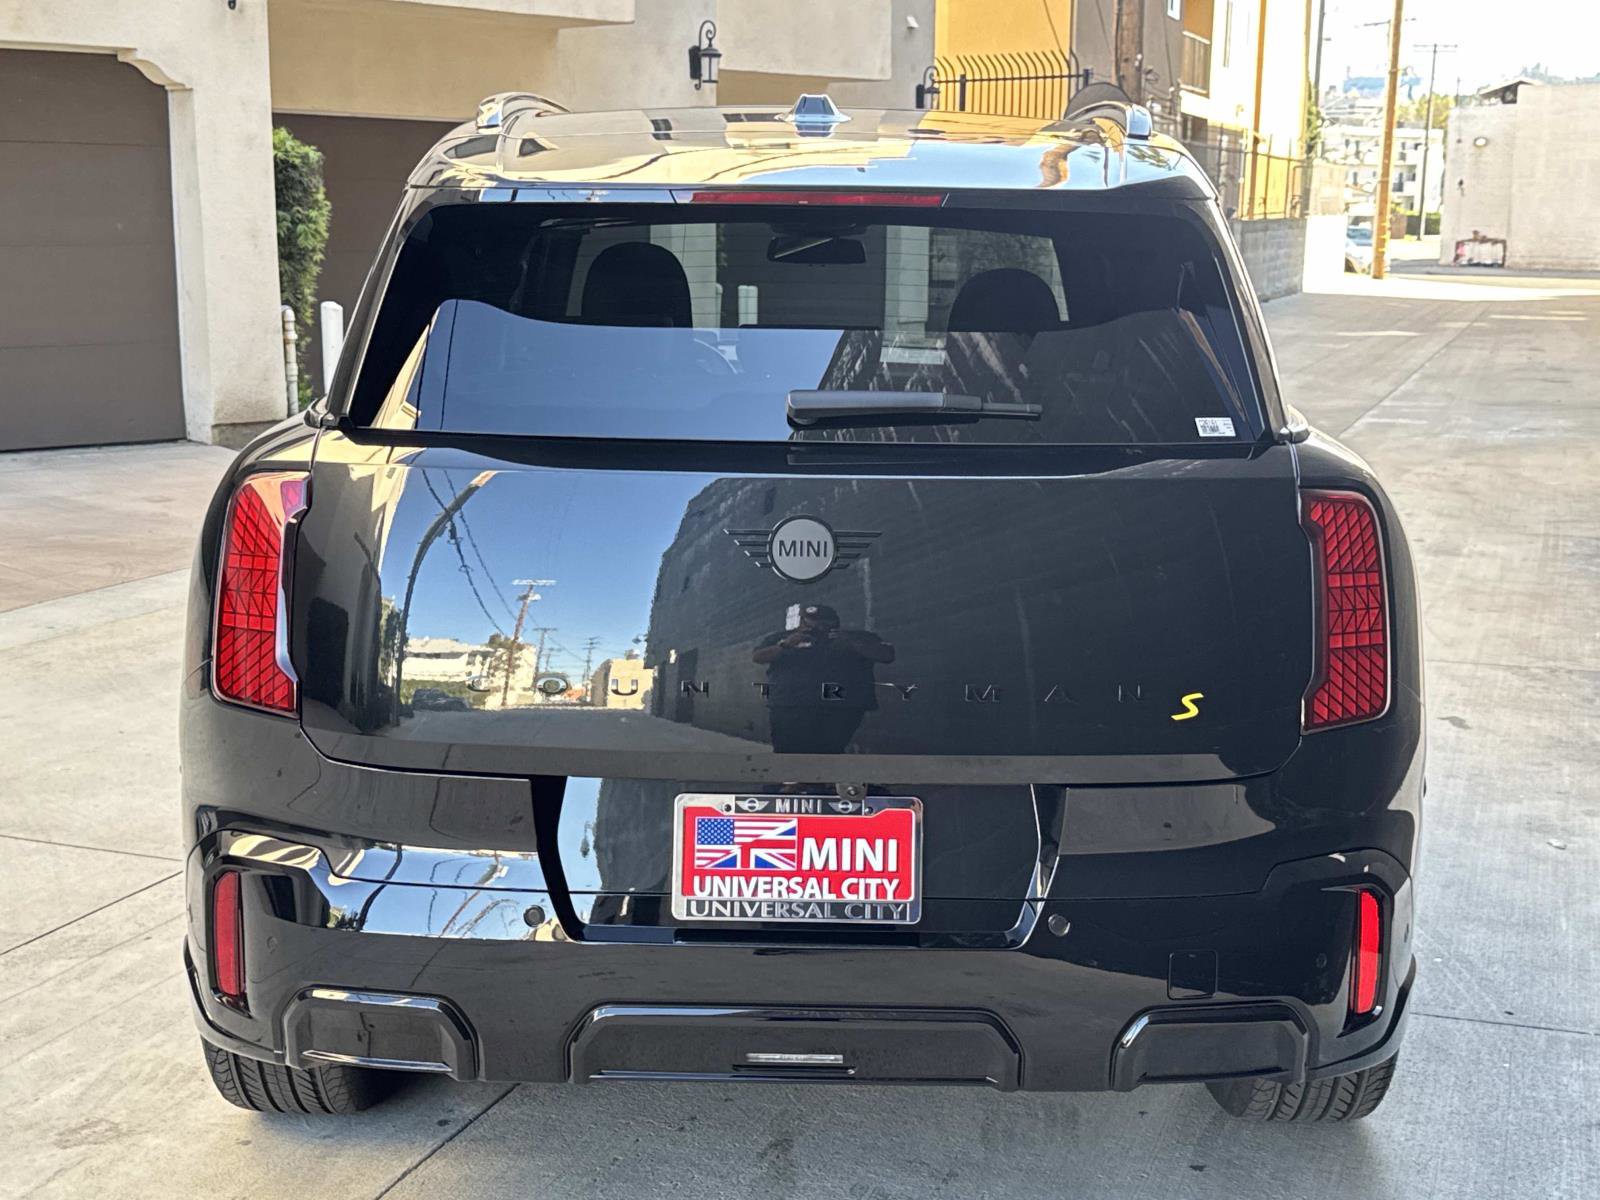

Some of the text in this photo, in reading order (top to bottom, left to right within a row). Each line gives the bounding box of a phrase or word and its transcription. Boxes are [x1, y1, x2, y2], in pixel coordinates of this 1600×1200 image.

[778, 540, 828, 557] MINI
[466, 673, 1205, 721] COUNTRYMAN S
[775, 798, 823, 814] MINI
[801, 837, 898, 872] MINI
[692, 875, 900, 900] UNIVERSAL CITY
[690, 901, 904, 920] UNIVERSAL CITY
